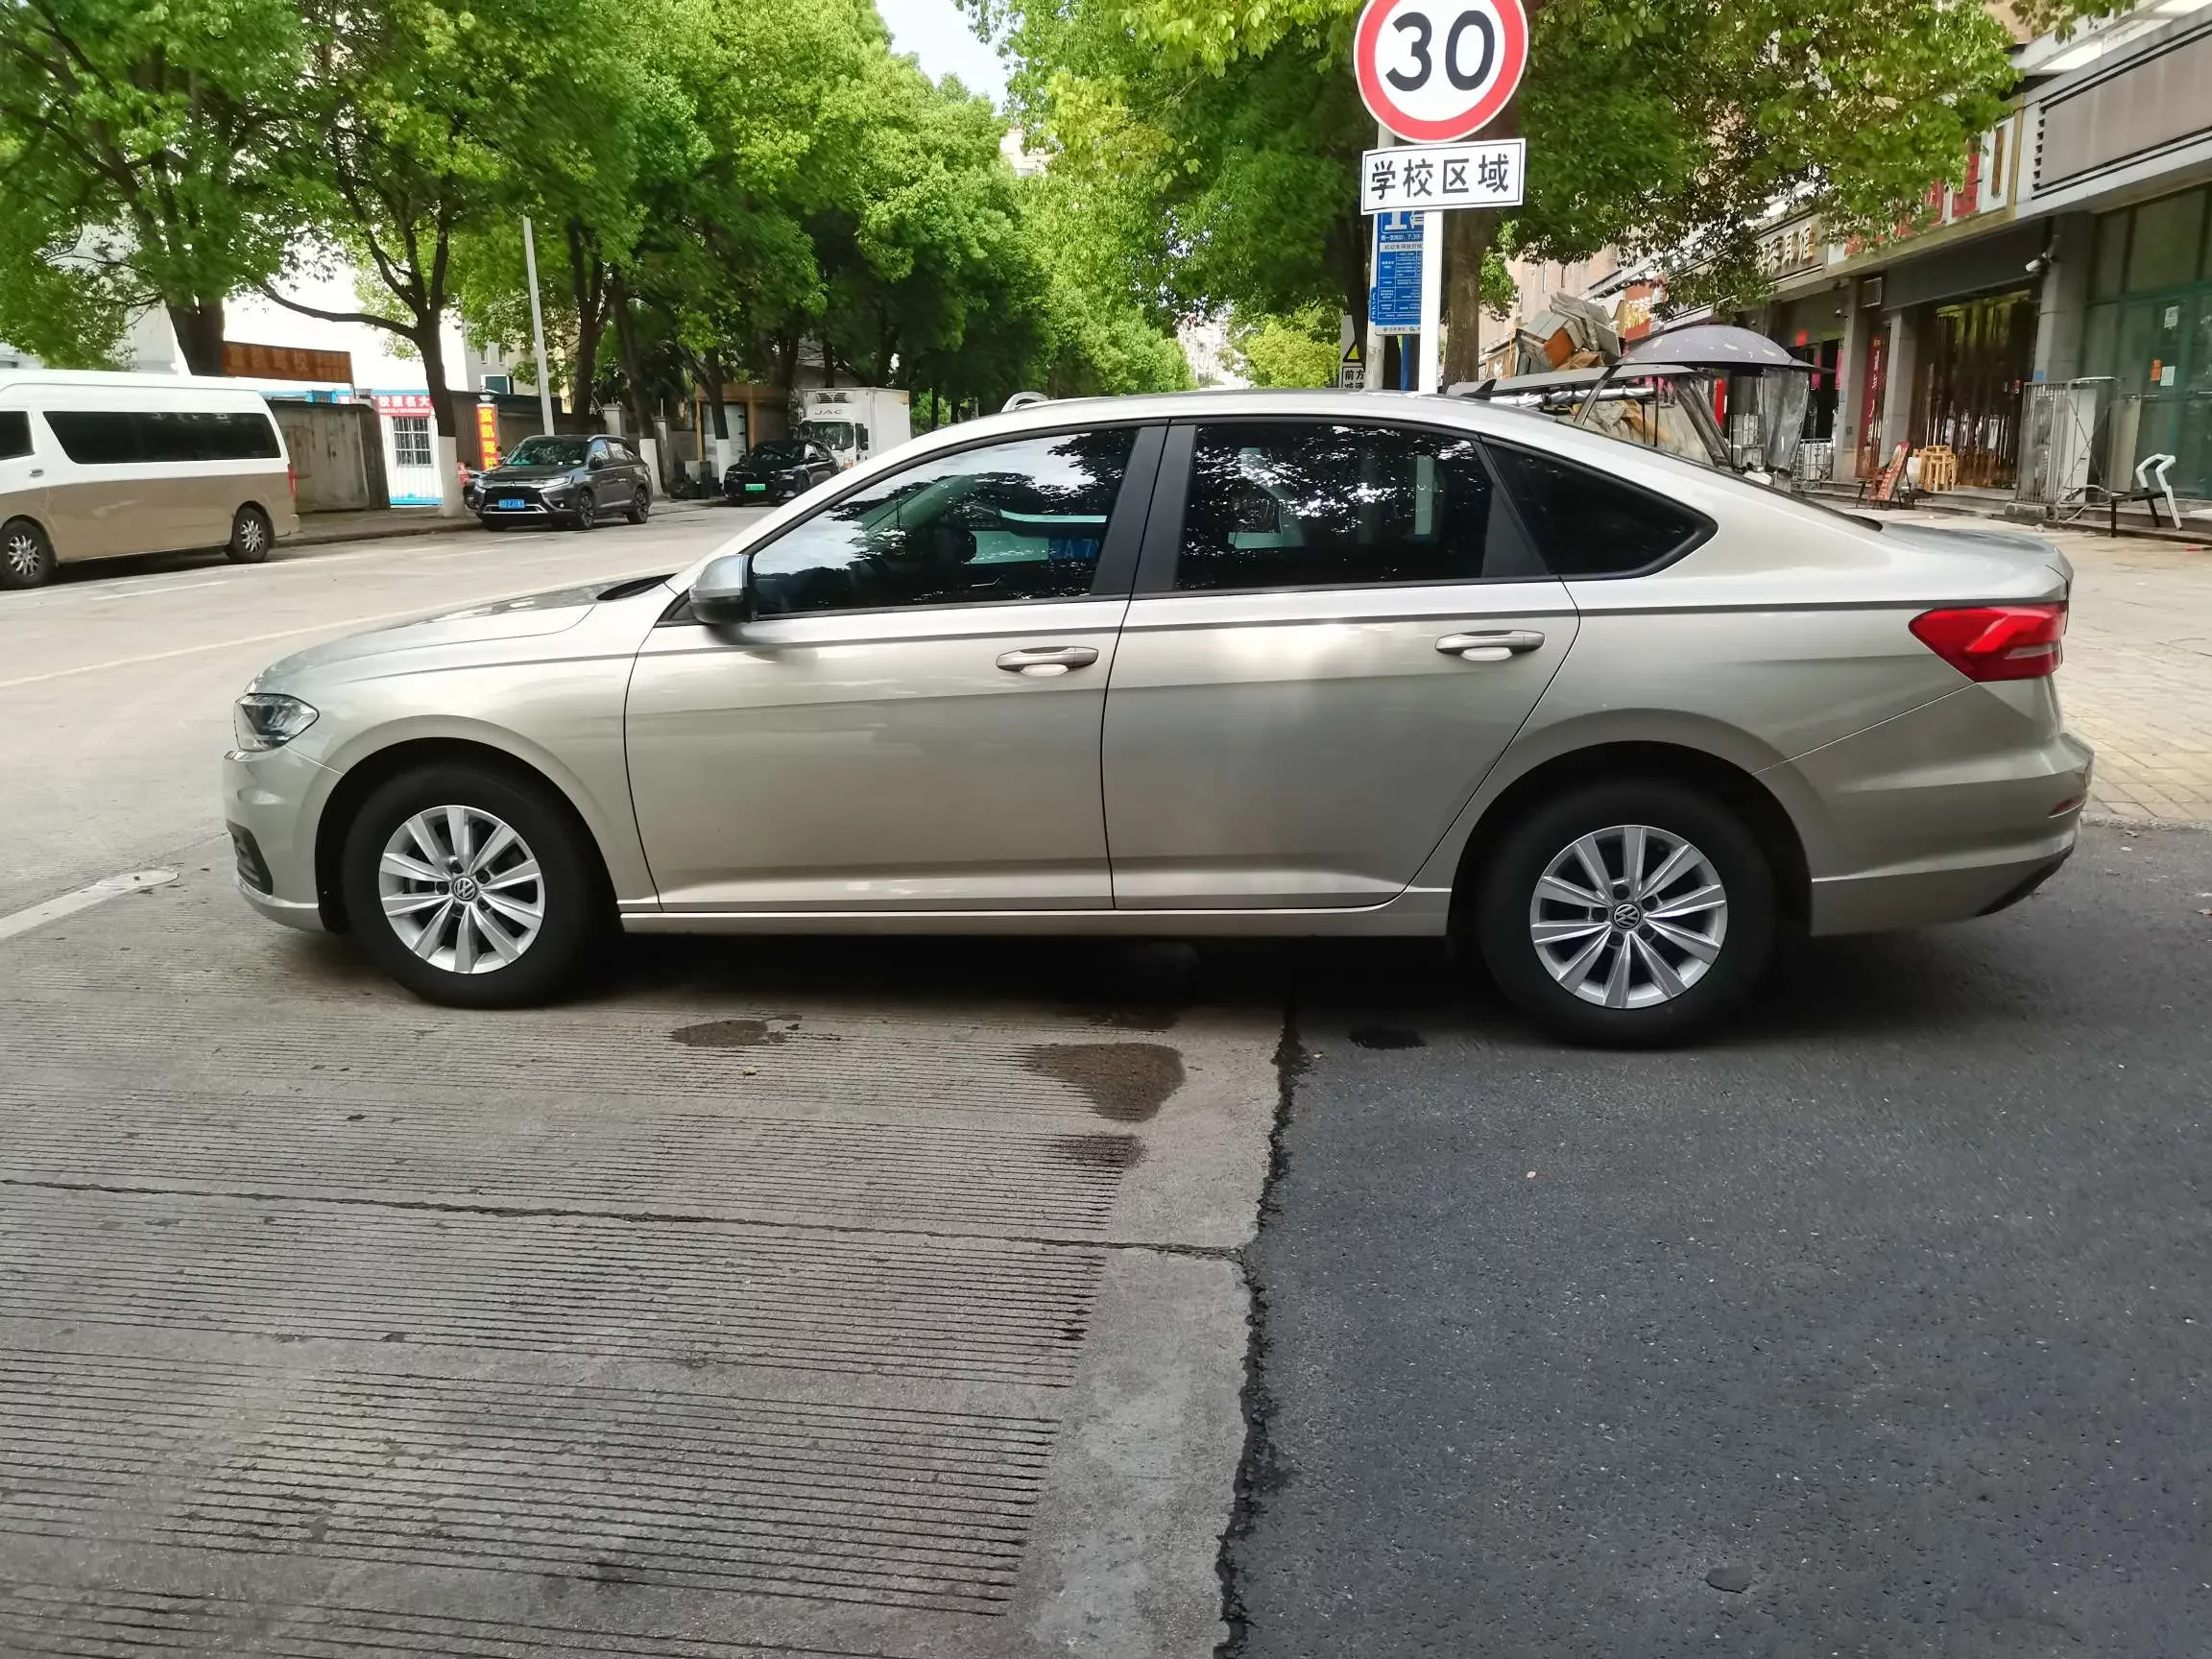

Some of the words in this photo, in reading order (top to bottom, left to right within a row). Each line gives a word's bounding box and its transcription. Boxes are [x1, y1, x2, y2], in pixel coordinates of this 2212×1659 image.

[1385, 10, 1495, 91] 30
[1371, 154, 1509, 200] 学校区域
[1345, 369, 1364, 380] 前方
